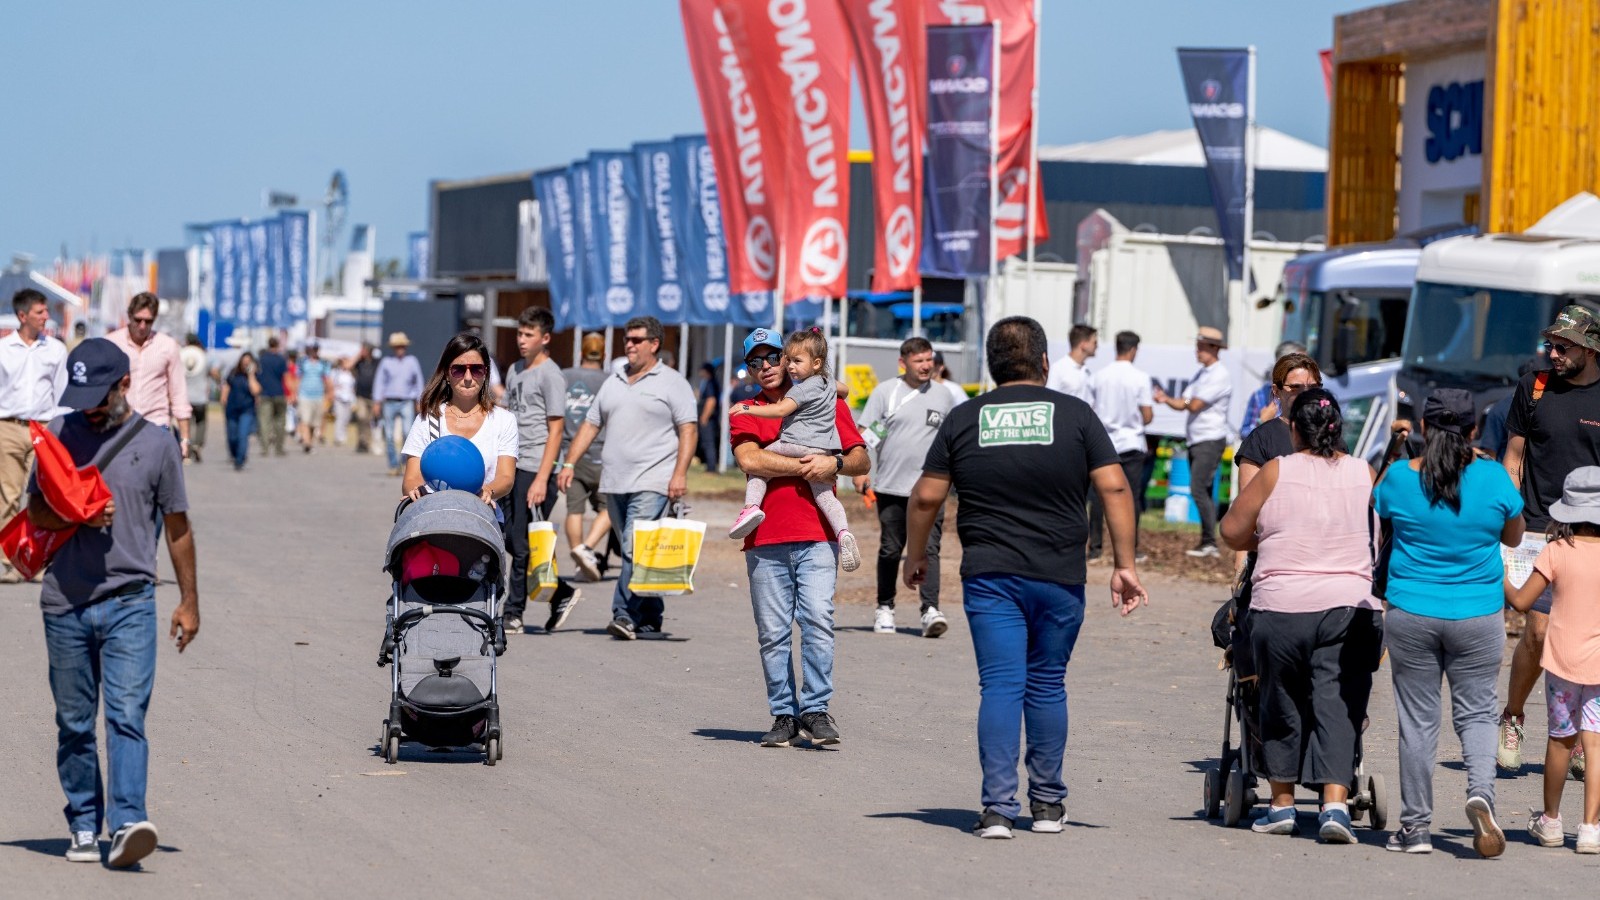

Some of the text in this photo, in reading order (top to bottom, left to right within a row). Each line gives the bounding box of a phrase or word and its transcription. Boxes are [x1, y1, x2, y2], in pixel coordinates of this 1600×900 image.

[984, 405, 1048, 428] VANS
[982, 426, 1049, 440] OFF THE WALL
